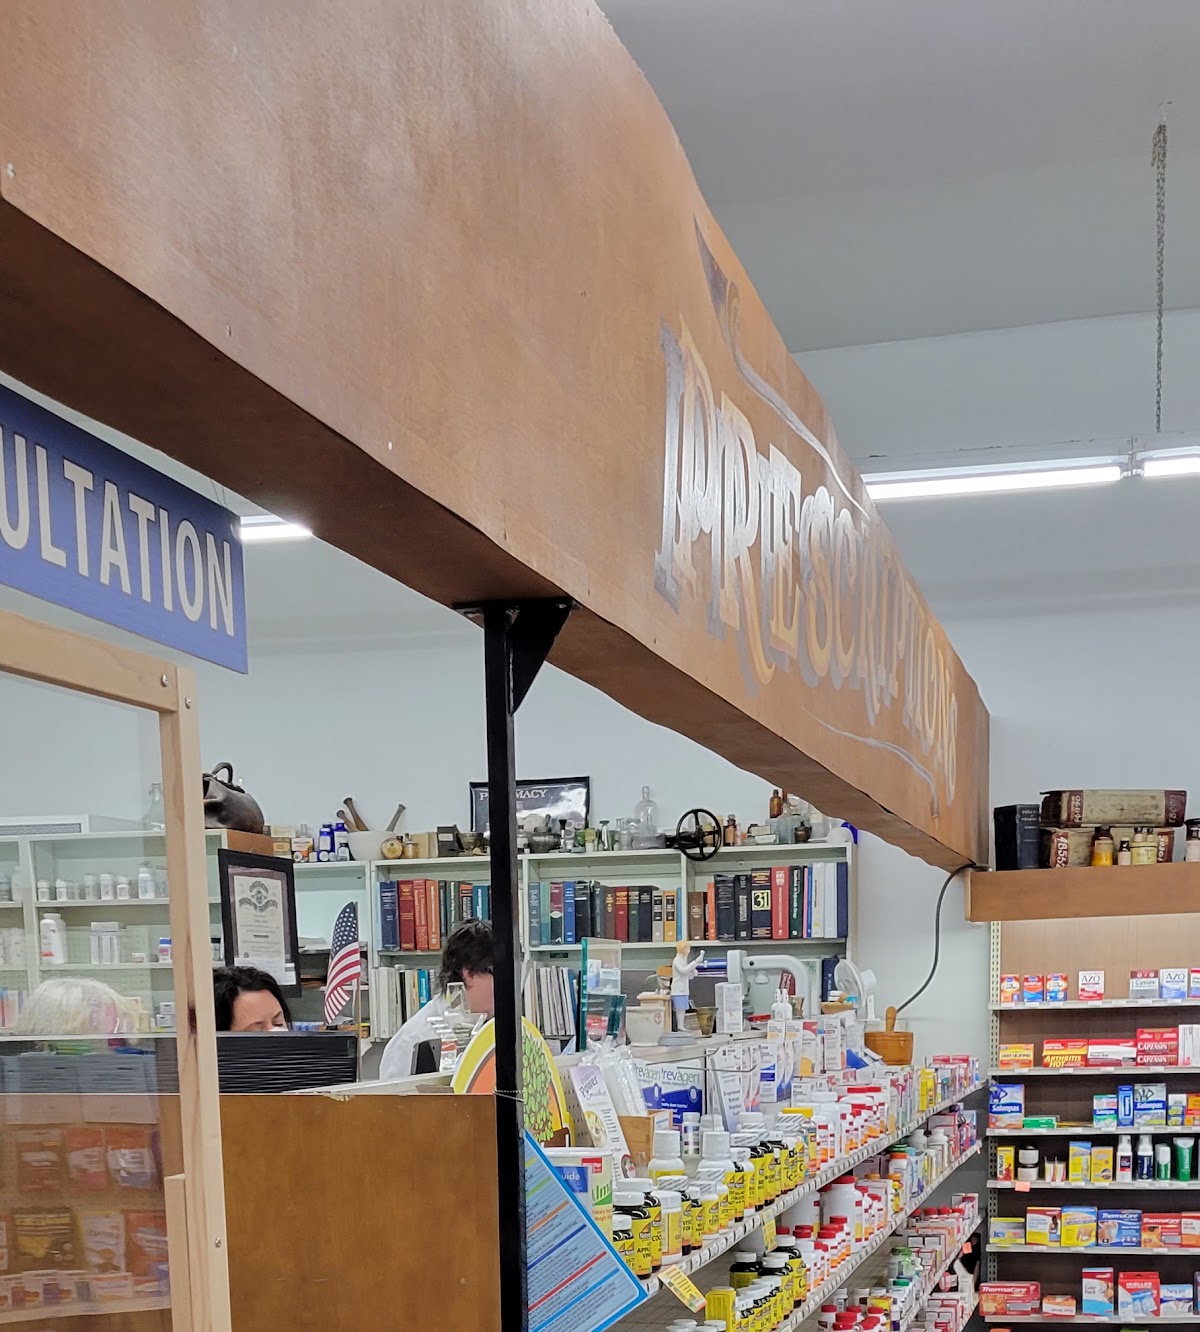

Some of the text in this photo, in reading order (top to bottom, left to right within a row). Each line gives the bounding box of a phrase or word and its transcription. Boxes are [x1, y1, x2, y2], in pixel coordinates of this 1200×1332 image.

[654, 312, 958, 807] PRESCRIPTIONS
[753, 890, 770, 909] 31
[1081, 974, 1100, 983] AZO
[1166, 972, 1186, 980] AZO
[661, 1067, 700, 1086] revagen
[991, 1104, 1020, 1113] Salonpas
[1136, 1102, 1163, 1110] Salonpas
[1143, 1217, 1181, 1225] ThermaCare
[981, 1286, 1028, 1294] ThermaCare
